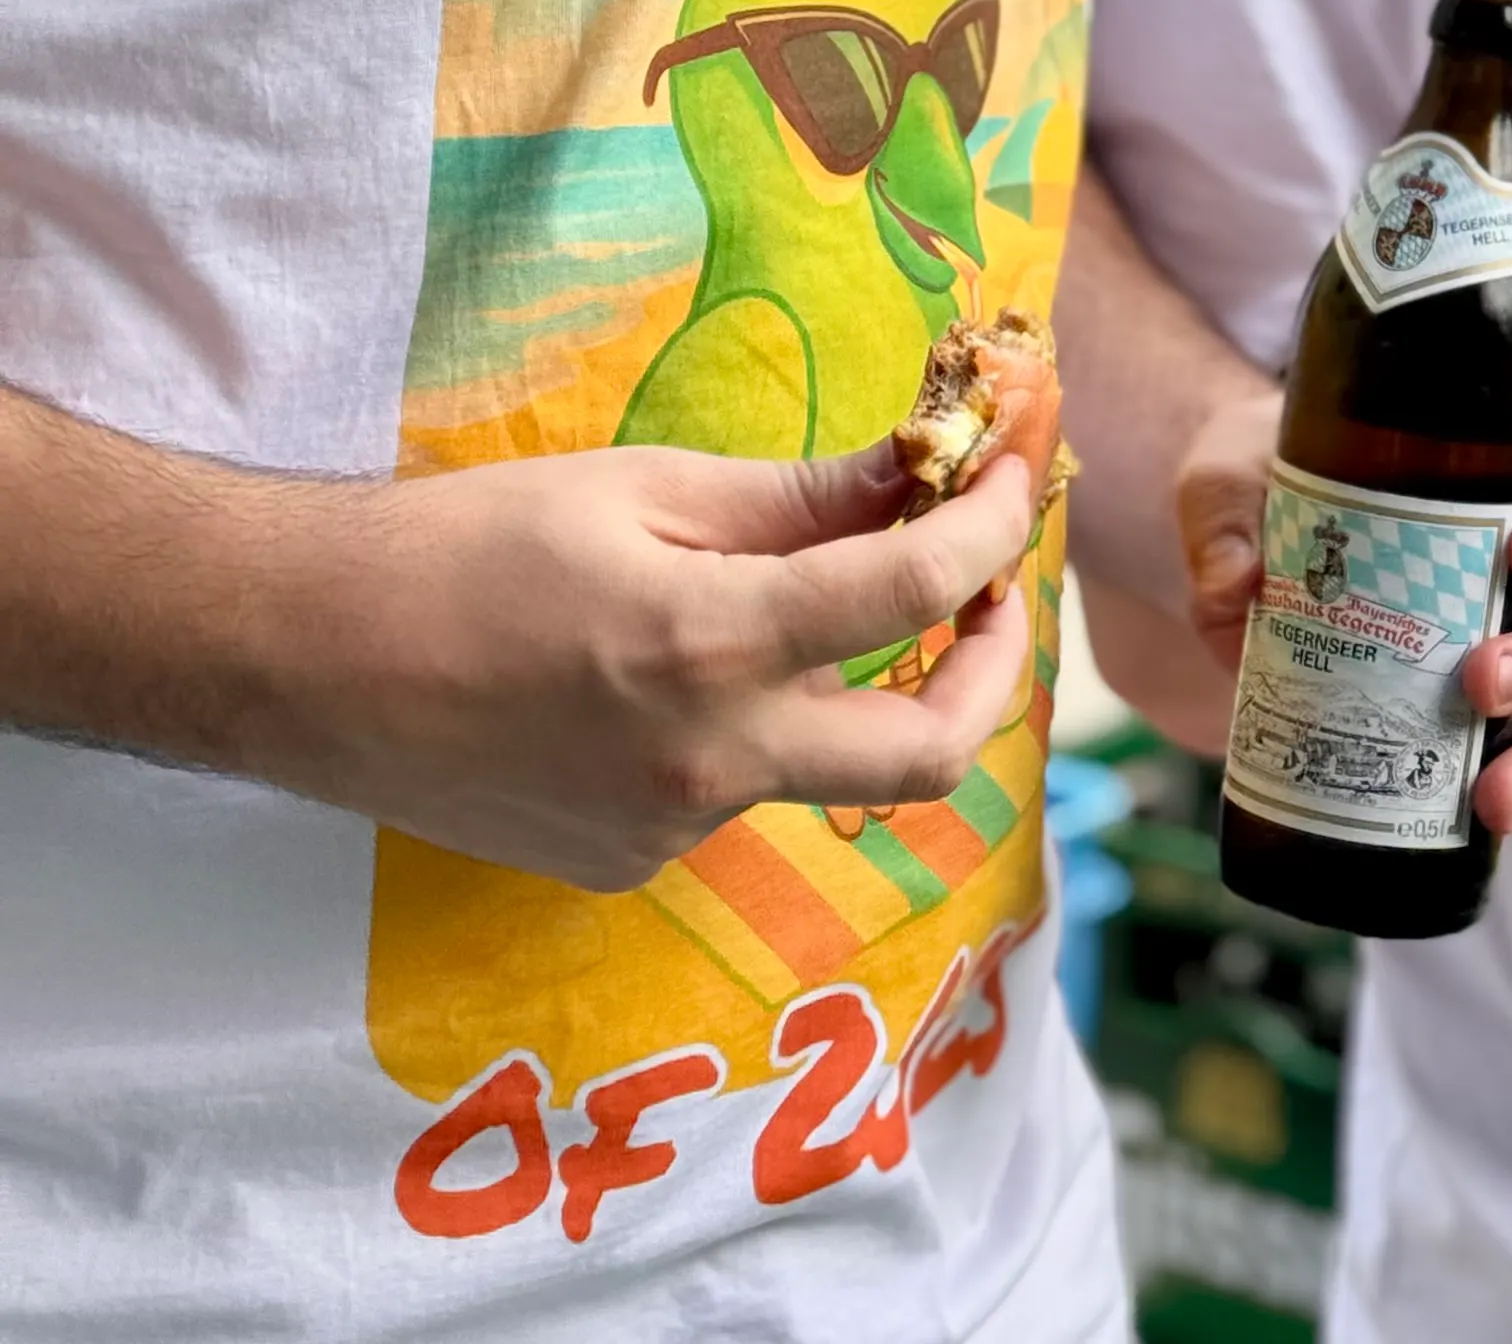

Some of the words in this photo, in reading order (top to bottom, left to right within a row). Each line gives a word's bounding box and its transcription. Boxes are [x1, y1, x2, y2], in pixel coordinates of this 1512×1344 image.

[1472, 230, 1511, 246] HELL
[1269, 617, 1377, 662] TEGERNSEER
[1292, 648, 1333, 673] HELL
[395, 1054, 720, 1243] OF
